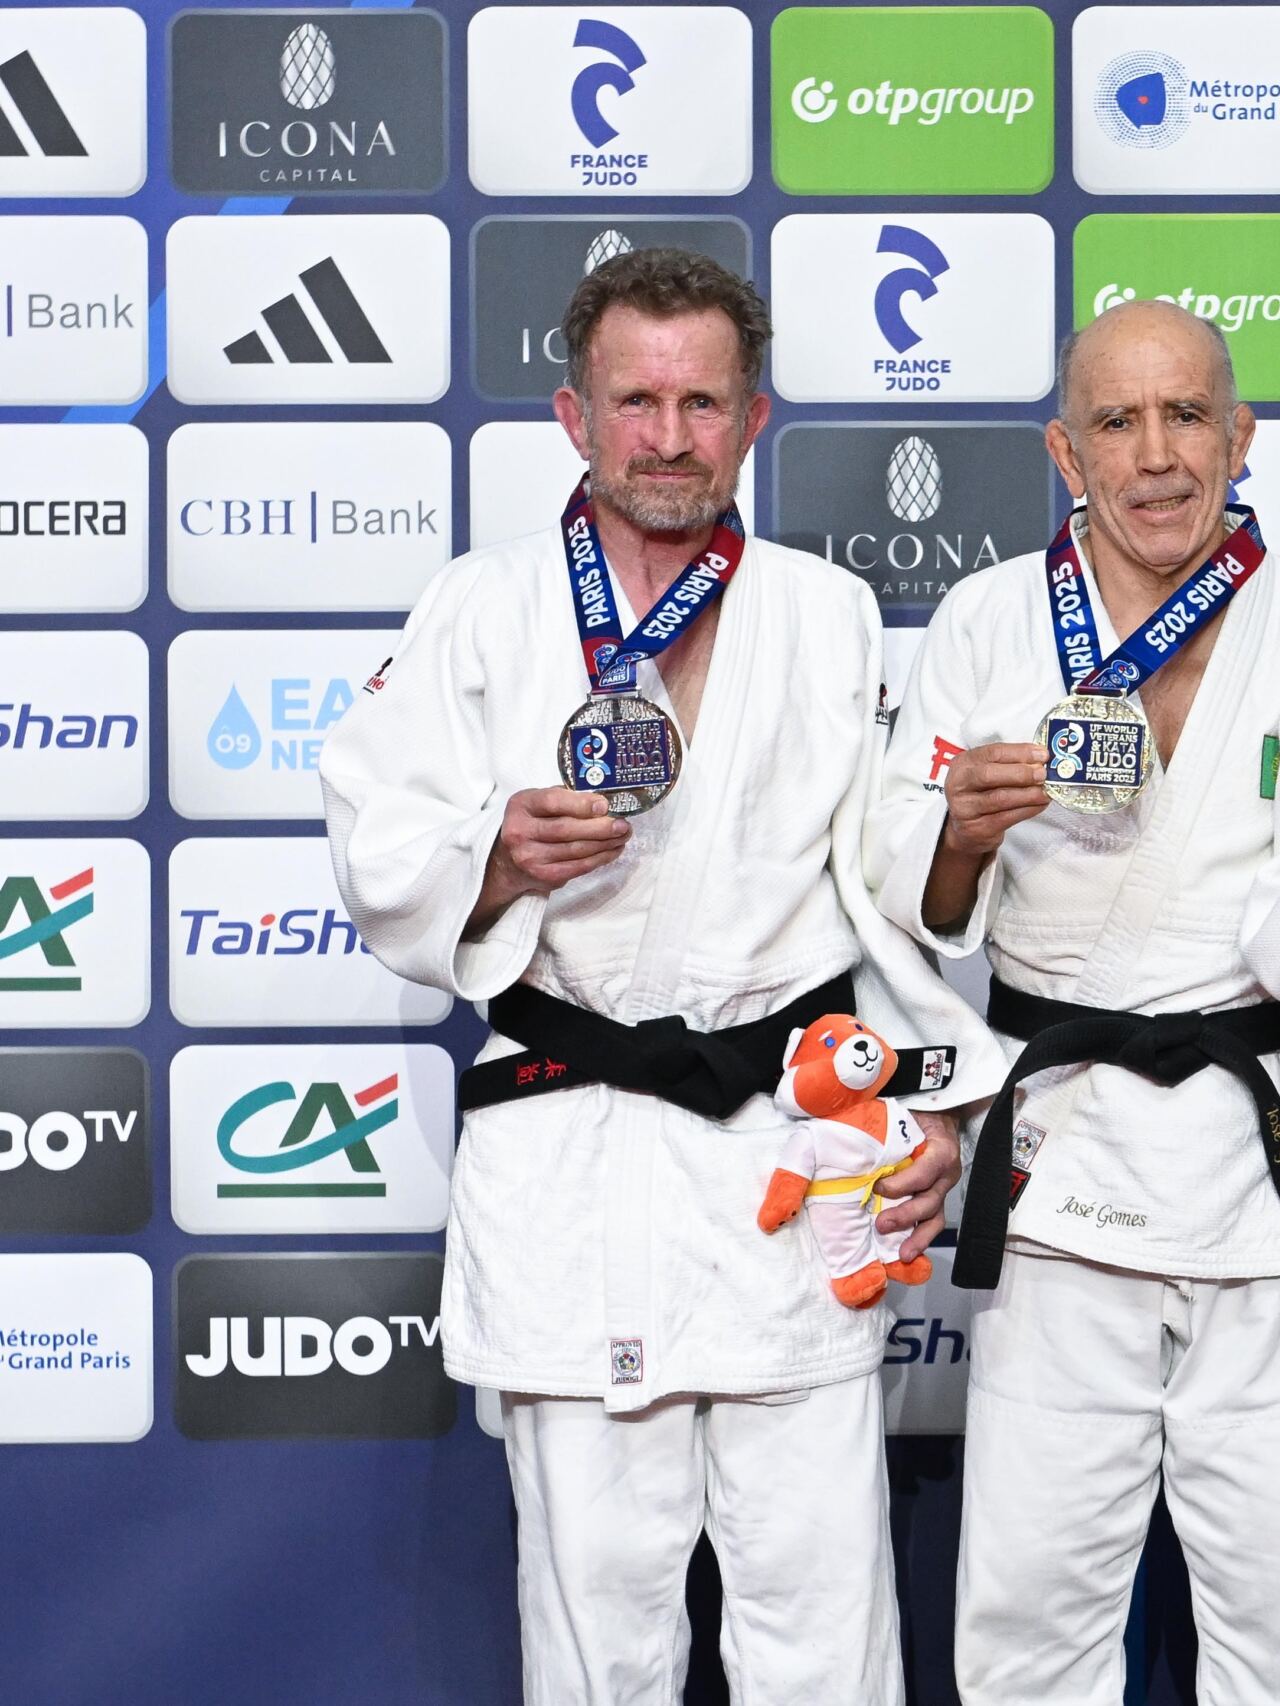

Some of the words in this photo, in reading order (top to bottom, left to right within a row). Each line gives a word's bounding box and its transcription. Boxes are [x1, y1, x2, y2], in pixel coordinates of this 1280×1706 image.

[848, 81, 1034, 125] otpgroup
[1194, 103, 1208, 114] du
[1212, 101, 1275, 121] Grand
[218, 121, 396, 157] ICONA
[570, 154, 648, 168] FRANCE
[259, 169, 357, 182] CAPITAL
[583, 172, 637, 186] JUDO
[27, 293, 135, 329] Bank
[874, 359, 951, 374] FRANCE
[885, 377, 940, 391] JUDO
[180, 499, 297, 536] CBH
[331, 500, 437, 535] Bank
[568, 515, 597, 571] 2025
[825, 533, 1001, 570] ICONA
[674, 552, 729, 605] PARIS
[869, 581, 949, 595] APITA
[1187, 553, 1245, 611] PARIS
[578, 568, 611, 628] PARIS
[1052, 561, 1086, 629] 2025
[642, 601, 691, 639] 2025
[1145, 601, 1196, 653] 2025
[272, 678, 354, 731] EA
[625, 723, 660, 734] WORLD
[1089, 733, 1138, 742] VETERANS
[1103, 725, 1139, 734] WORLD
[627, 740, 662, 752] KATA
[1091, 741, 1101, 751] &
[1102, 742, 1136, 753] KATA
[615, 751, 664, 769] JUDO
[1087, 752, 1137, 768] JUDO
[616, 773, 642, 784] PARIS
[1086, 773, 1112, 782] PARIS
[1113, 774, 1136, 783] 2025
[181, 909, 373, 955] TaiSh
[1056, 1195, 1097, 1218] José
[1096, 1204, 1148, 1228] Gomes
[0, 1328, 98, 1352] étropole
[8, 1351, 72, 1369] Grand
[80, 1351, 131, 1369] Paris
